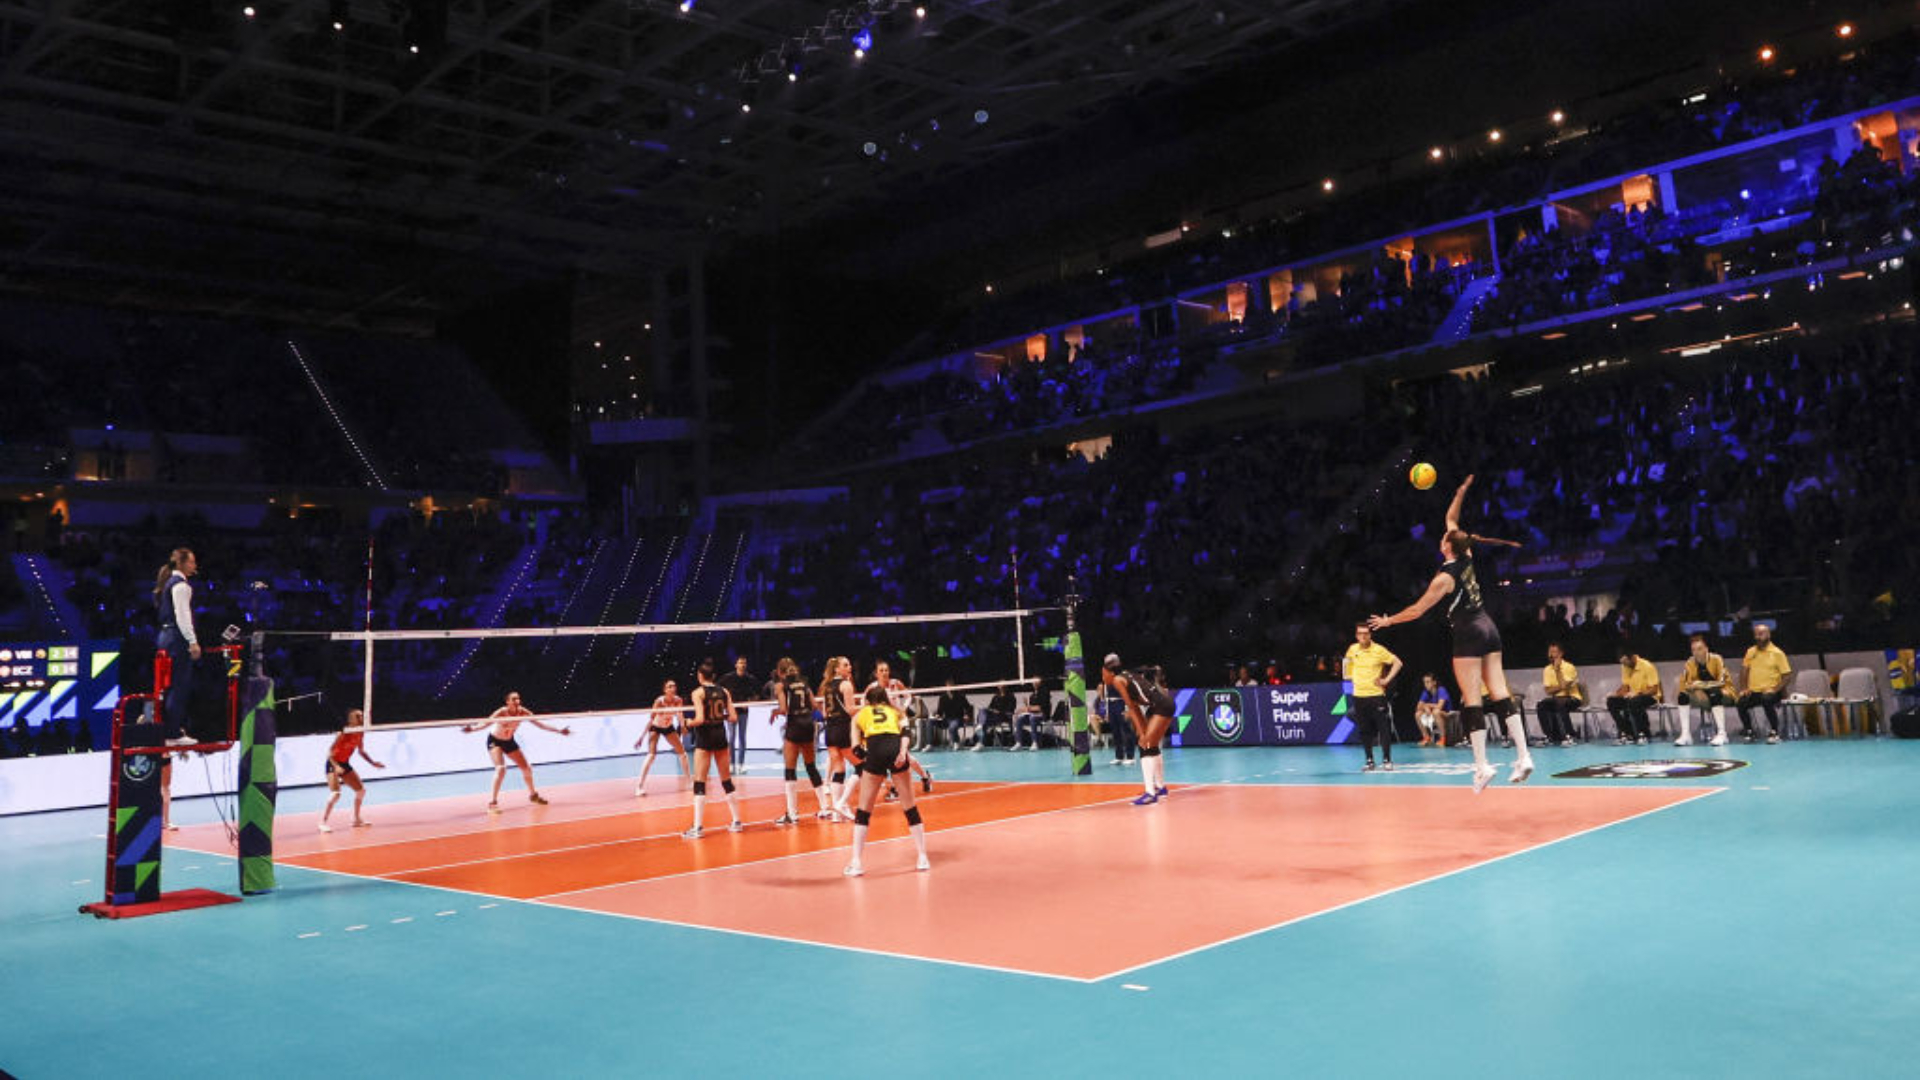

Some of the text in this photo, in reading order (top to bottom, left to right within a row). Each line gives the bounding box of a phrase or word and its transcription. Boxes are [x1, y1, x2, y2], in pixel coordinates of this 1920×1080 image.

[1214, 694, 1231, 702] CEV
[1271, 690, 1310, 706] Super
[871, 708, 888, 723] 5
[1272, 708, 1311, 722] Finals
[1275, 725, 1305, 739] Turin
